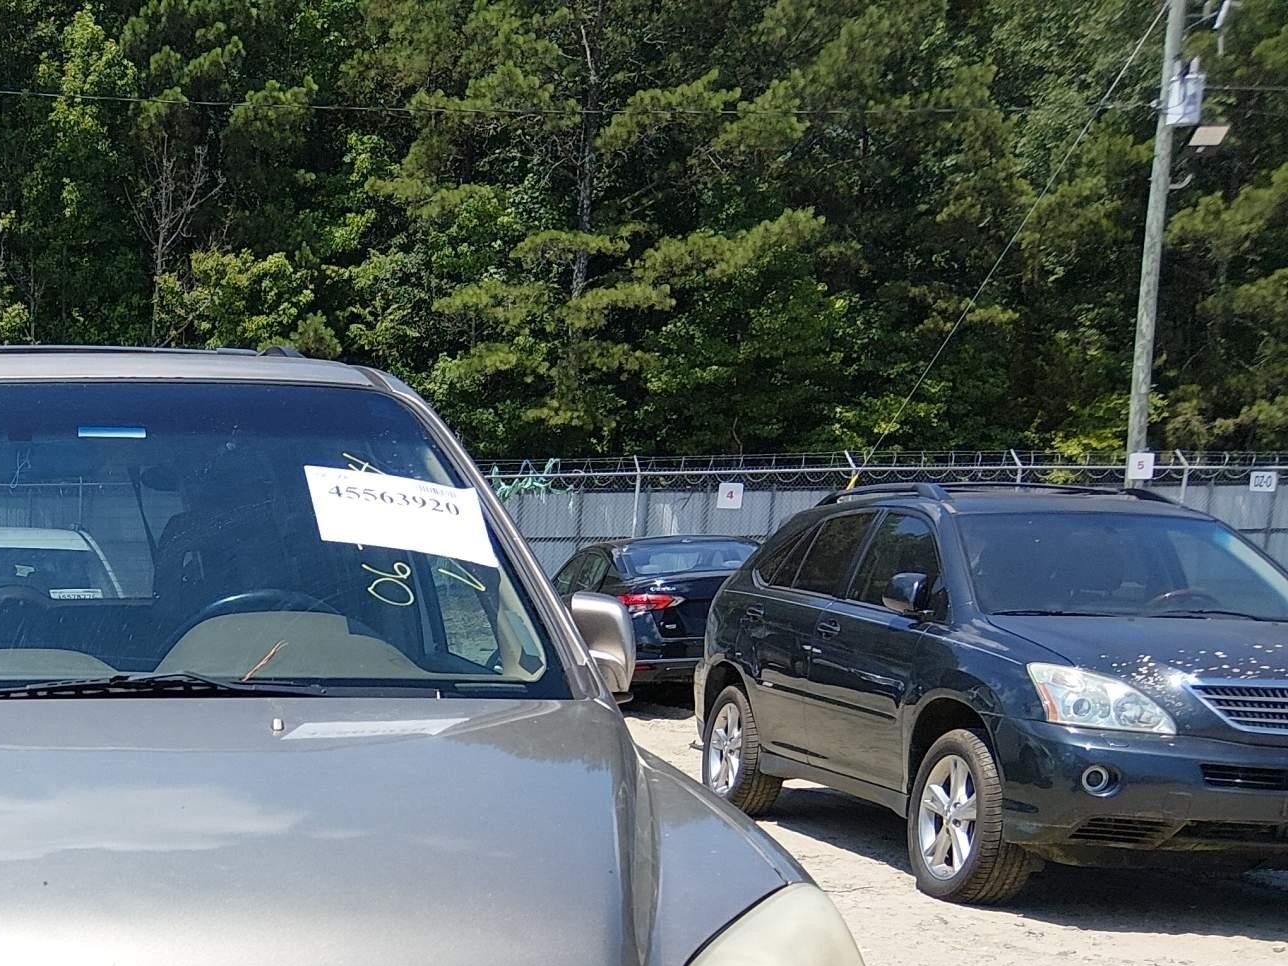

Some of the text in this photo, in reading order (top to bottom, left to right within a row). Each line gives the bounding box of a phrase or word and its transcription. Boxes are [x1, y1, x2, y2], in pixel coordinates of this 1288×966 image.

[1137, 460, 1145, 470] 5
[328, 484, 461, 516] 45563920
[726, 490, 734, 500] 4
